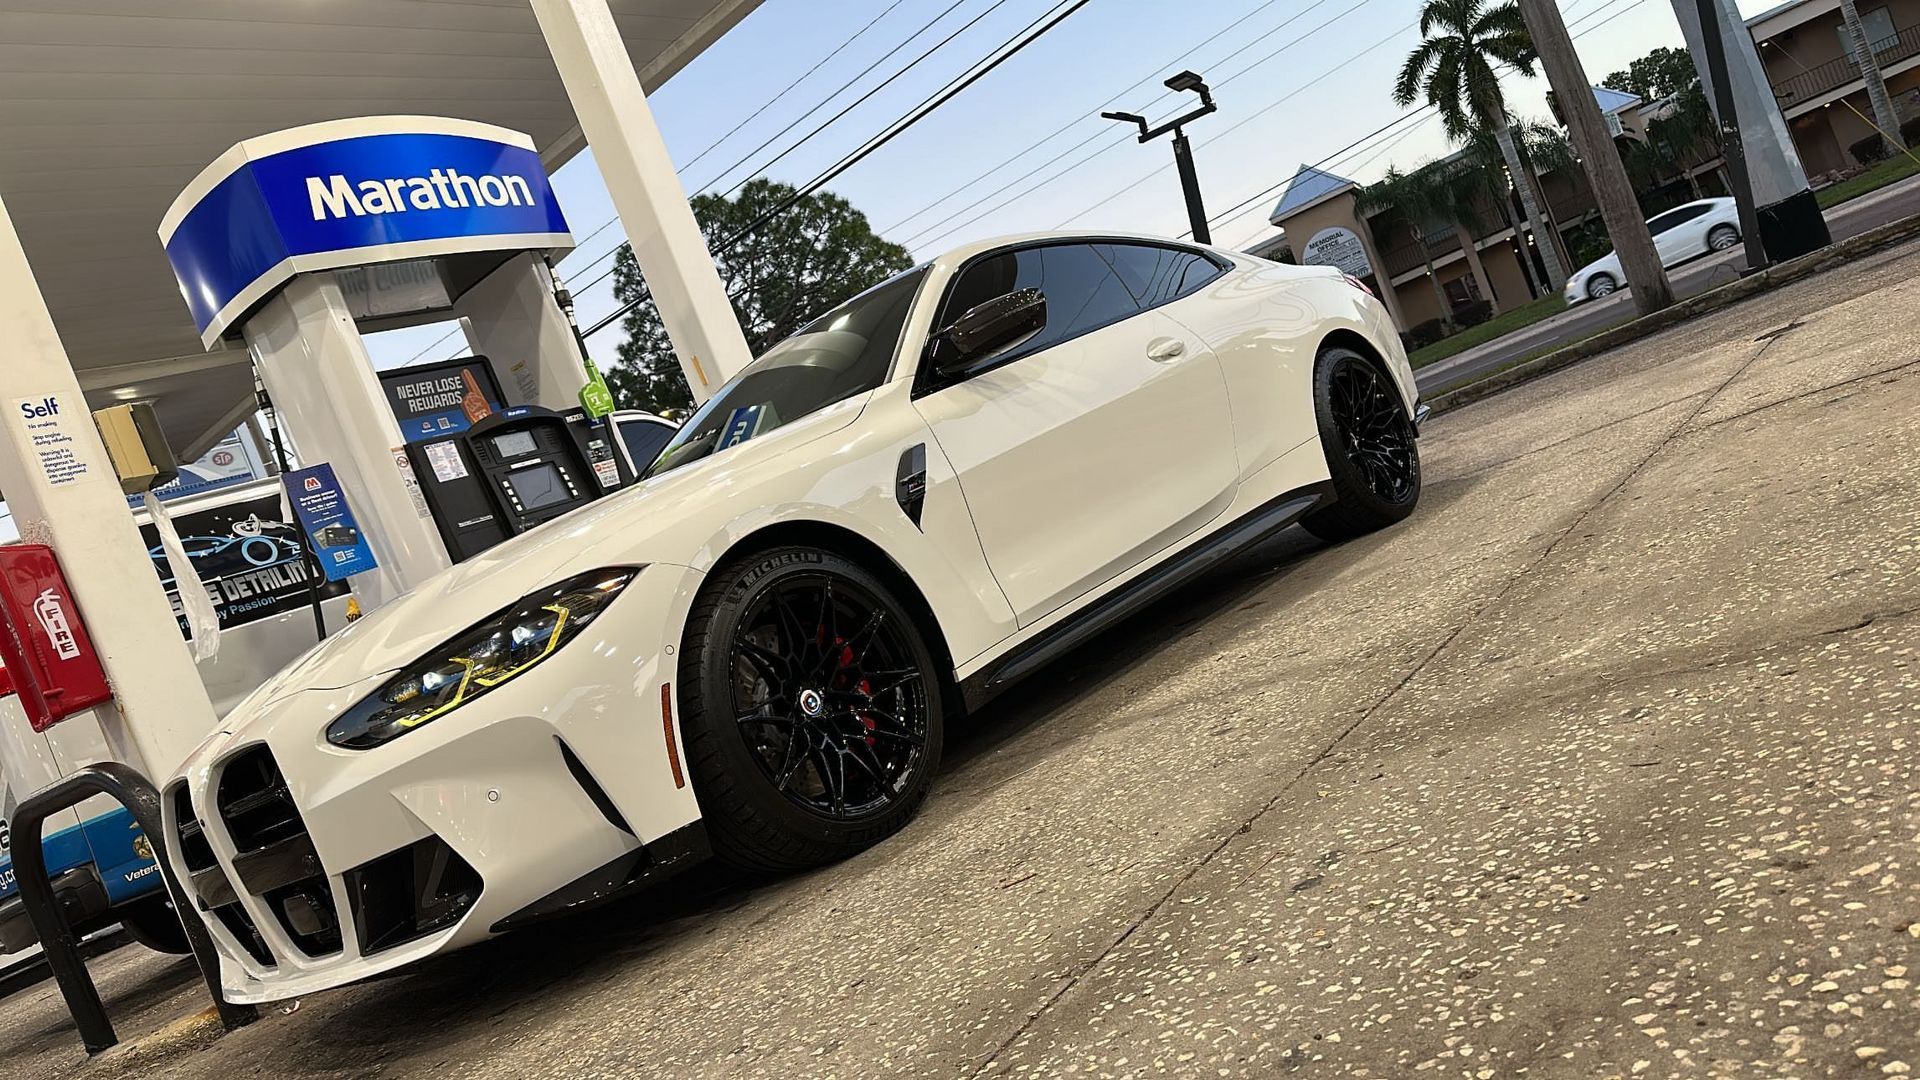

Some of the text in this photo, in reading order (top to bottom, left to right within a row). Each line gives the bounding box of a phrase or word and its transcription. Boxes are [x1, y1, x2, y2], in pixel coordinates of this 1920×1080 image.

[305, 168, 535, 222] Marathon
[1309, 231, 1344, 249] MEMORIAL
[1316, 240, 1340, 253] OFFICE
[396, 376, 463, 399] NEVER LOSE
[21, 397, 59, 419] Self
[408, 391, 463, 413] REWARDS
[214, 453, 232, 465] STP
[221, 561, 319, 601] DETAILIN
[744, 552, 819, 588] MICHELIN
[229, 596, 276, 615] Passion
[45, 608, 75, 654] FIRE
[124, 864, 160, 882] Vetera
